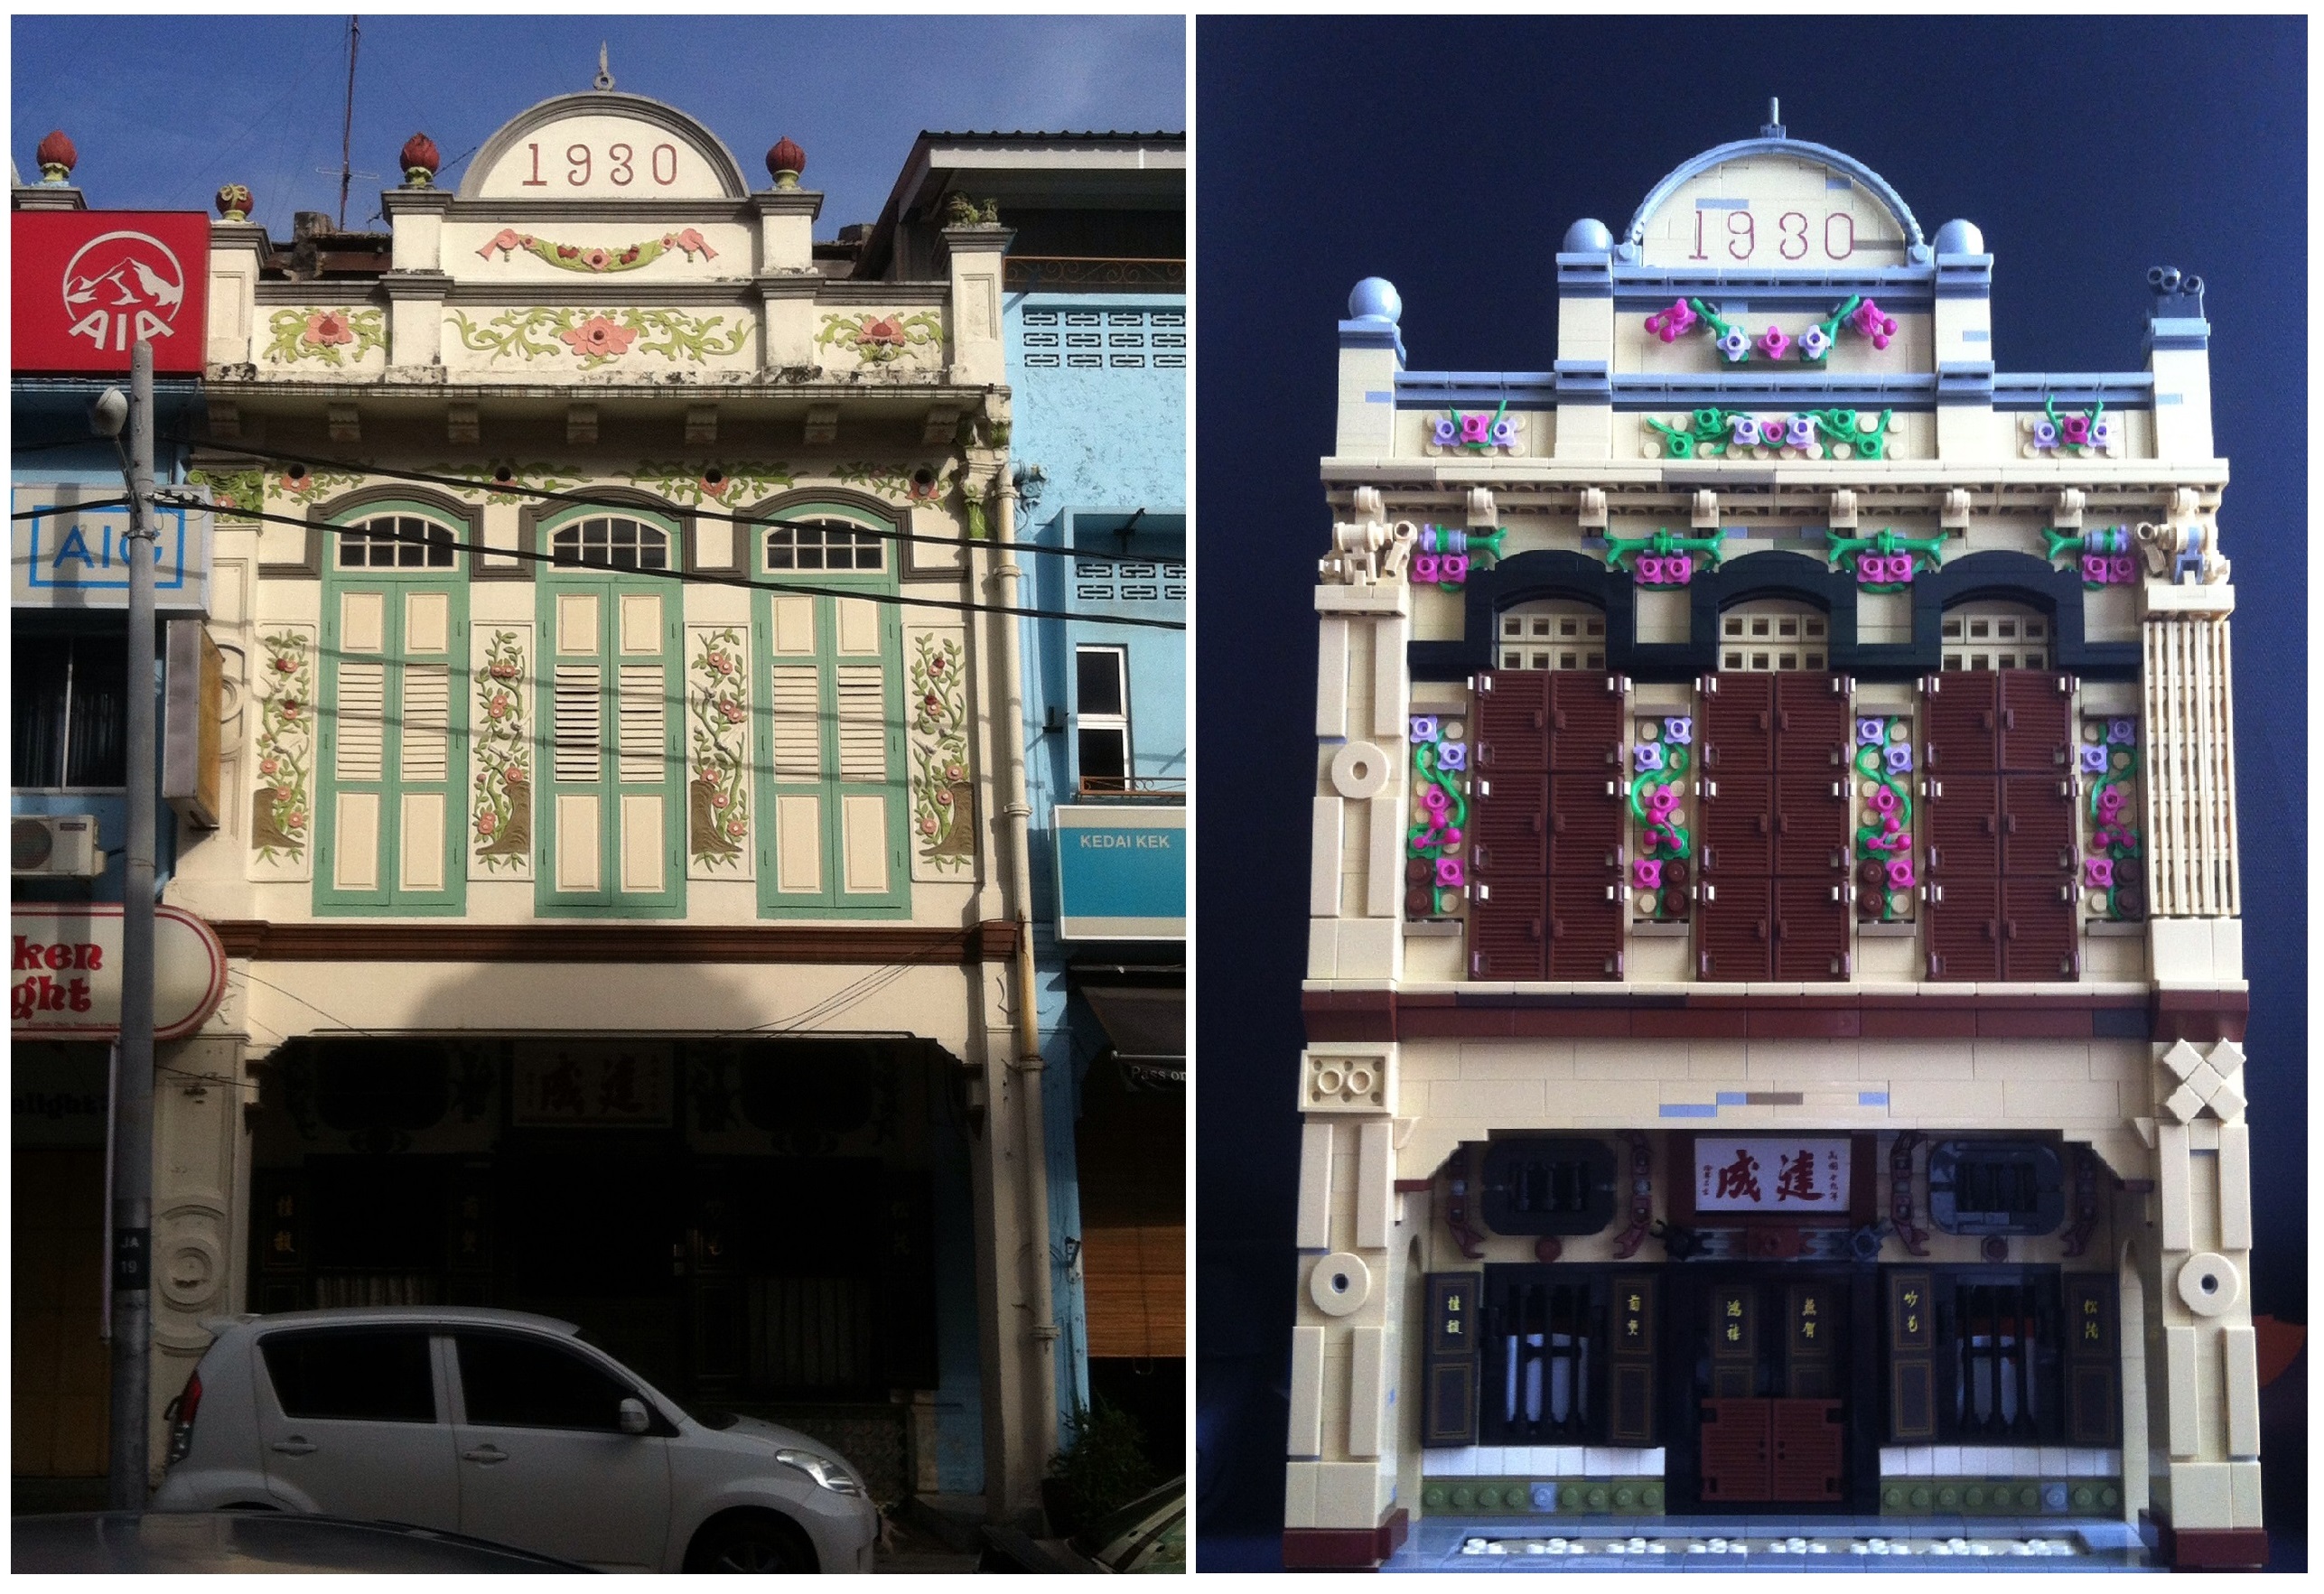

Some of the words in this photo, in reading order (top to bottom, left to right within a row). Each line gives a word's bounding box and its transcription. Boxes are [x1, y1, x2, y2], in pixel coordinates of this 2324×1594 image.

[521, 142, 678, 187] 1930
[1688, 210, 1854, 260] 1930
[69, 309, 175, 351] AIA
[1080, 834, 1131, 848] KEDAI
[1135, 834, 1170, 848] KEK
[120, 1235, 140, 1249] JA
[120, 1260, 138, 1274] 19
